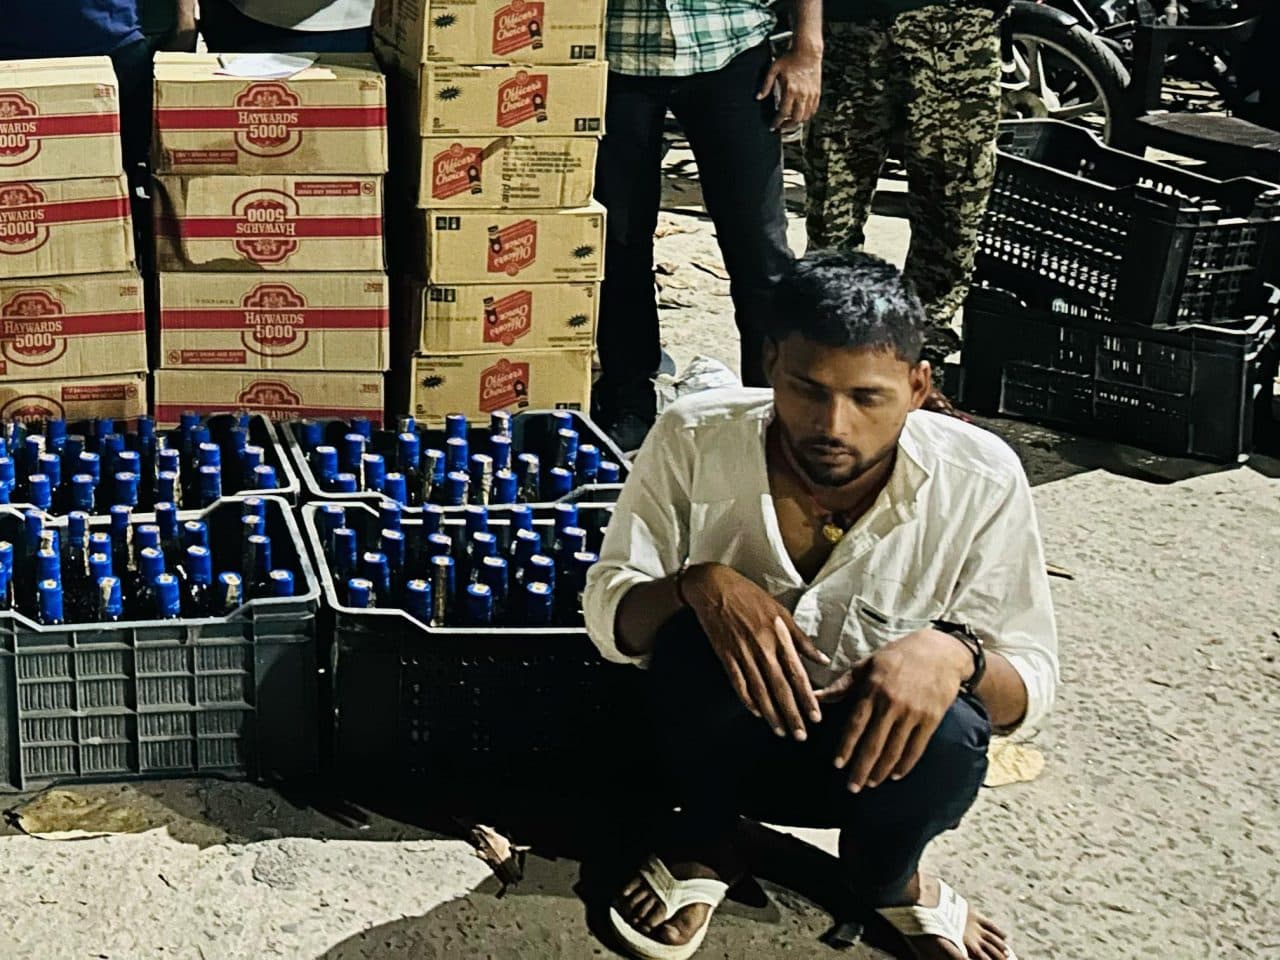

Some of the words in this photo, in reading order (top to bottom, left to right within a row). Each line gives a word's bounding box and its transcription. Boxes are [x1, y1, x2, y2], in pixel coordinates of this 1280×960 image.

[238, 111, 298, 124] HAYWARDS
[250, 124, 287, 138] 5000
[247, 208, 285, 222] 5000
[236, 222, 296, 235] HAYWARDS
[245, 312, 304, 325] HAYWARDS
[4, 320, 62, 334] HAYWARDS
[256, 325, 293, 339] 5000
[15, 333, 52, 348] 5000
